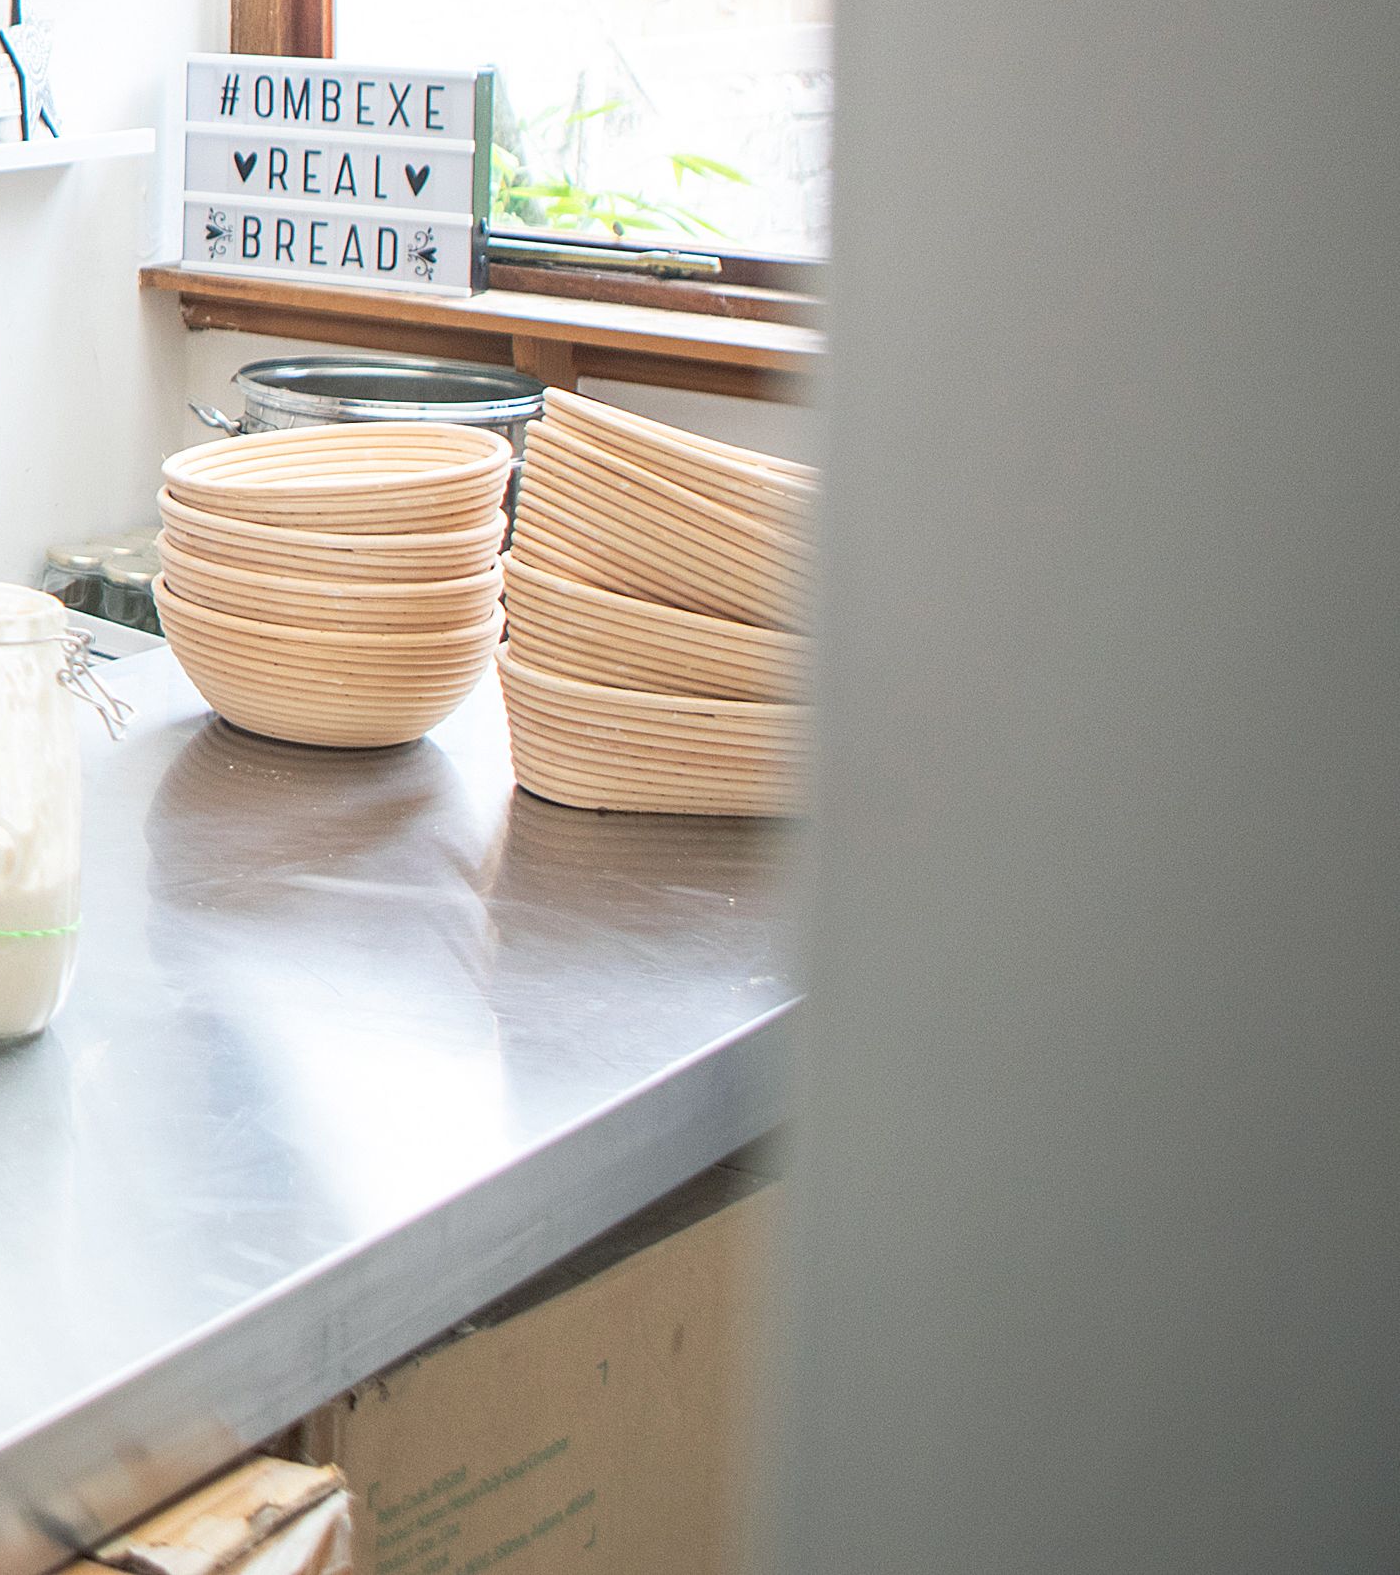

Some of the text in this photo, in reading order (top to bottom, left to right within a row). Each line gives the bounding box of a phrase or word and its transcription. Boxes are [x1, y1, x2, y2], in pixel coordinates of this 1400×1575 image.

[219, 72, 446, 131] #OMBEXE
[267, 146, 388, 200] REAL
[241, 214, 399, 273] BREAD
